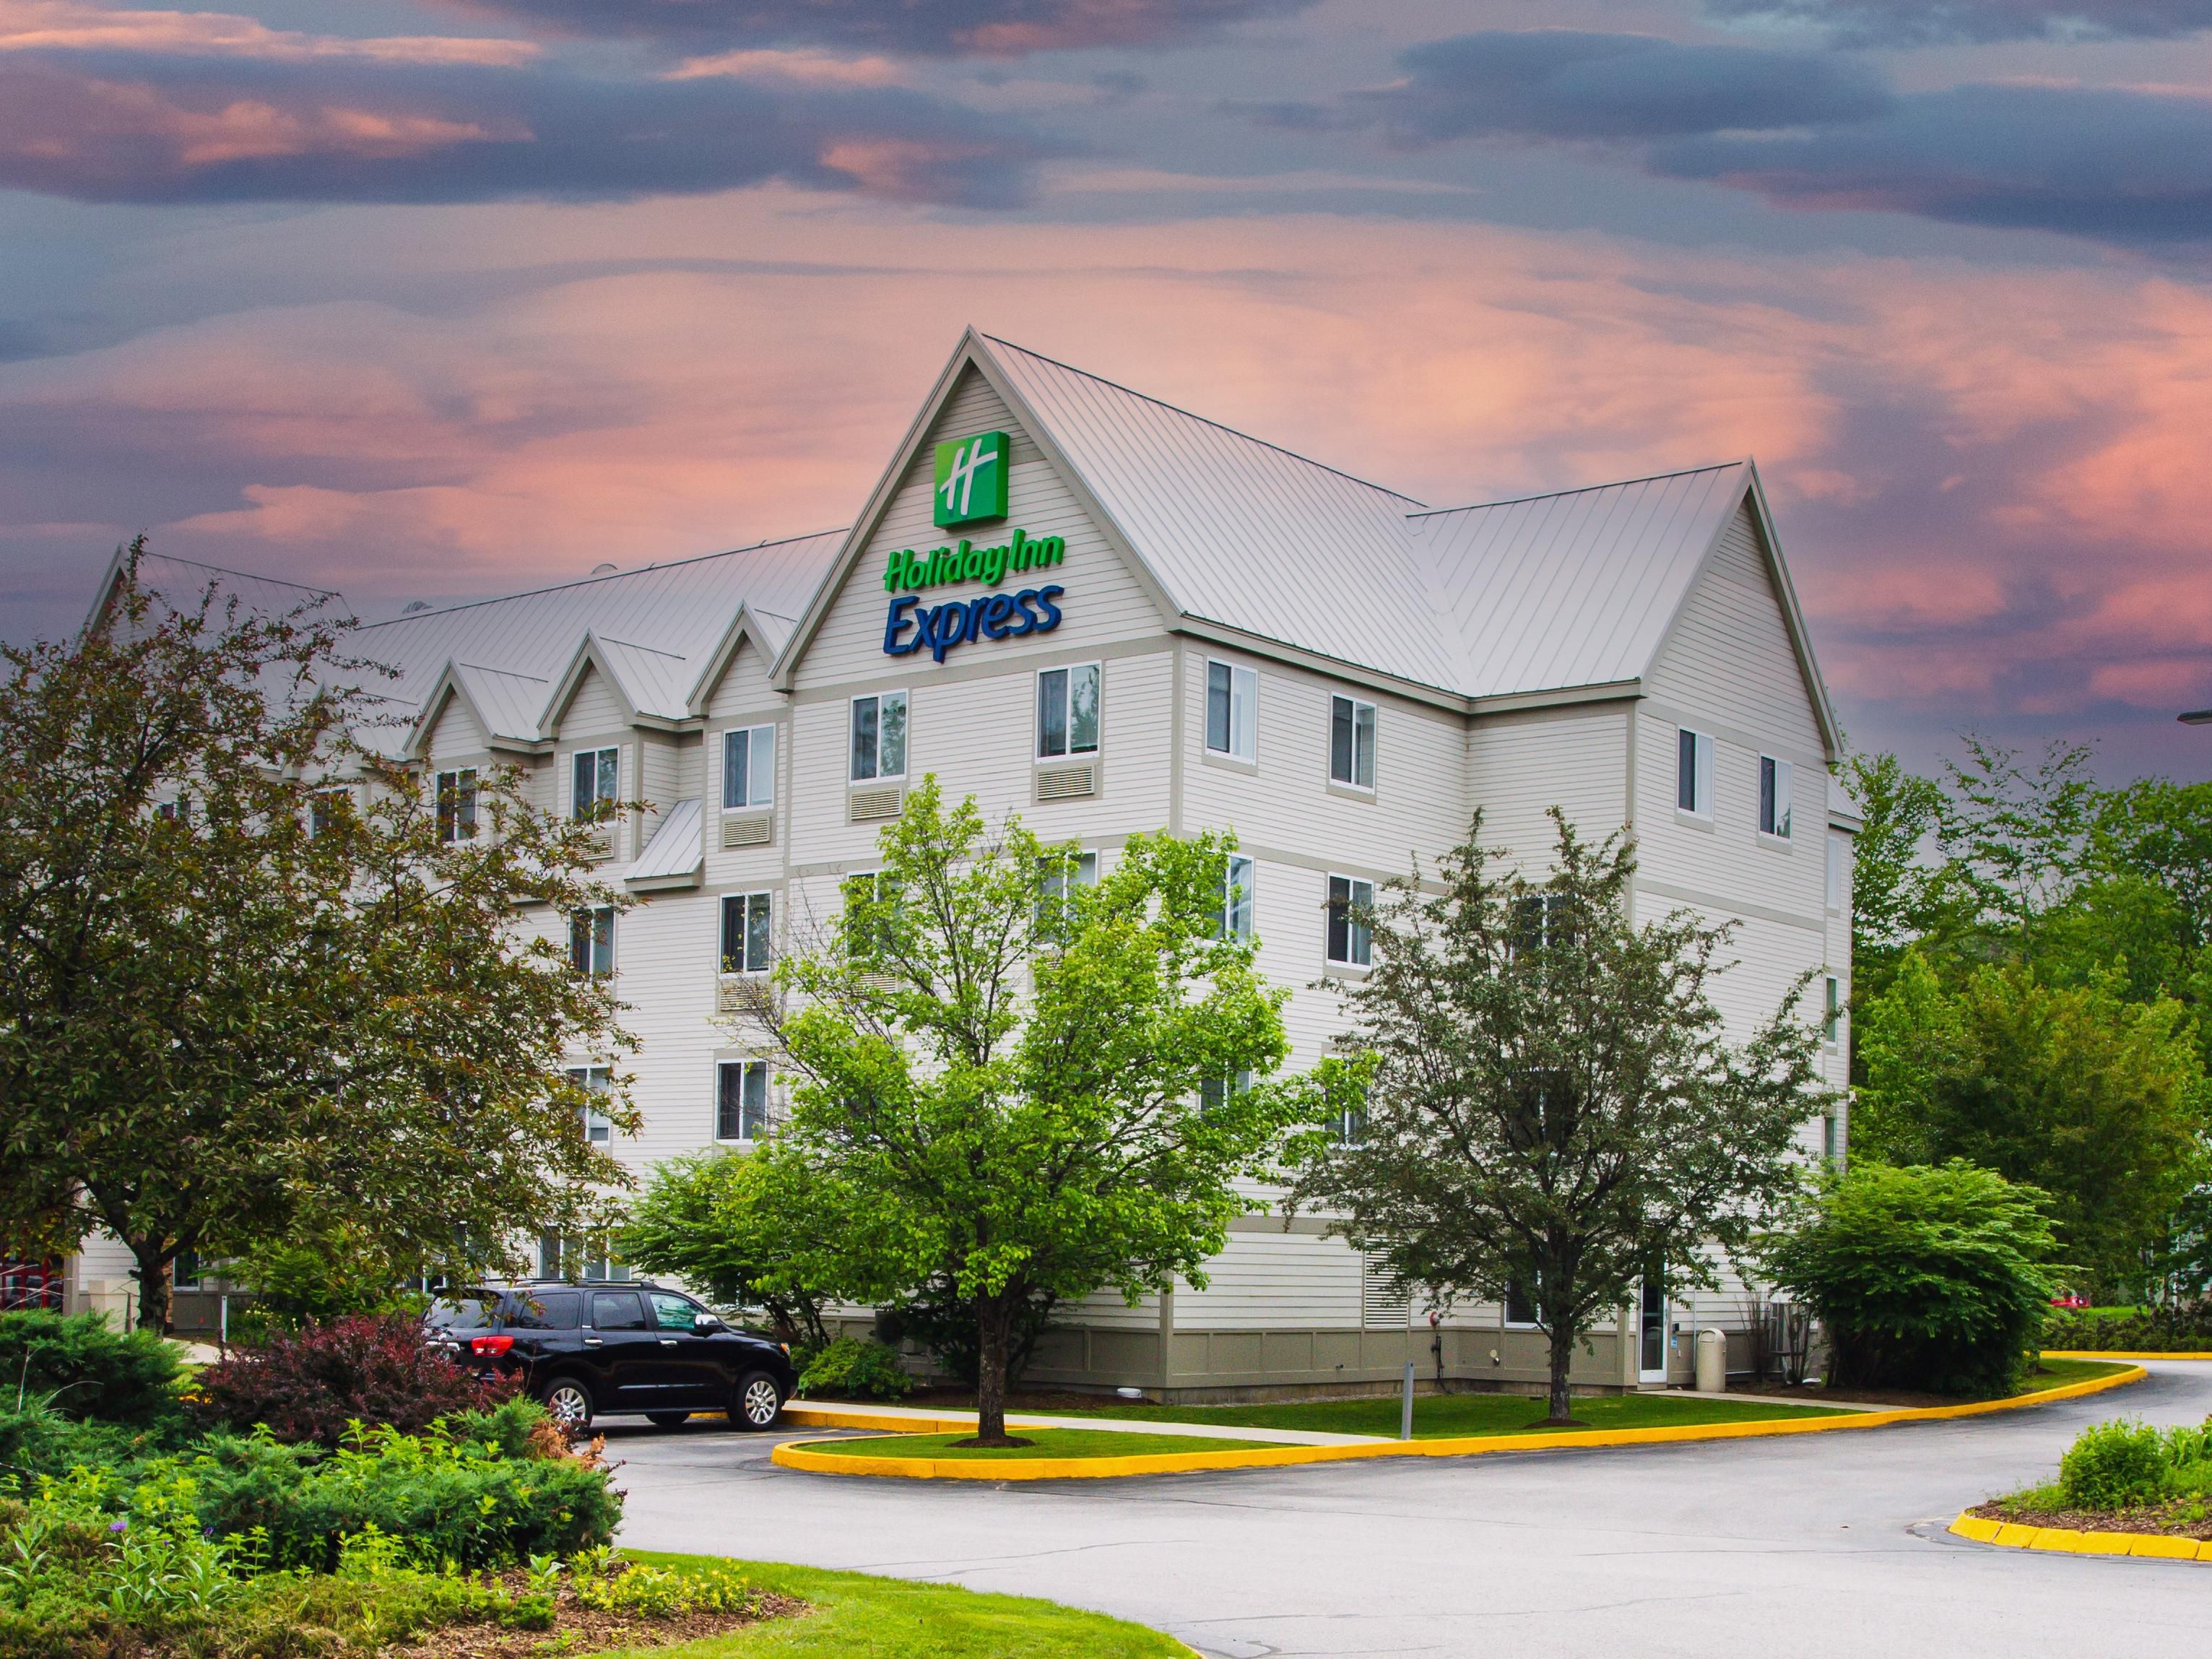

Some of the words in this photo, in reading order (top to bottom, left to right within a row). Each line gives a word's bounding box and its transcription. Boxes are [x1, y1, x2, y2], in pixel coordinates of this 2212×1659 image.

[940, 438, 998, 515] H
[883, 540, 1009, 592] Holiday
[1009, 529, 1064, 573] Inn
[883, 585, 1064, 663] Express
